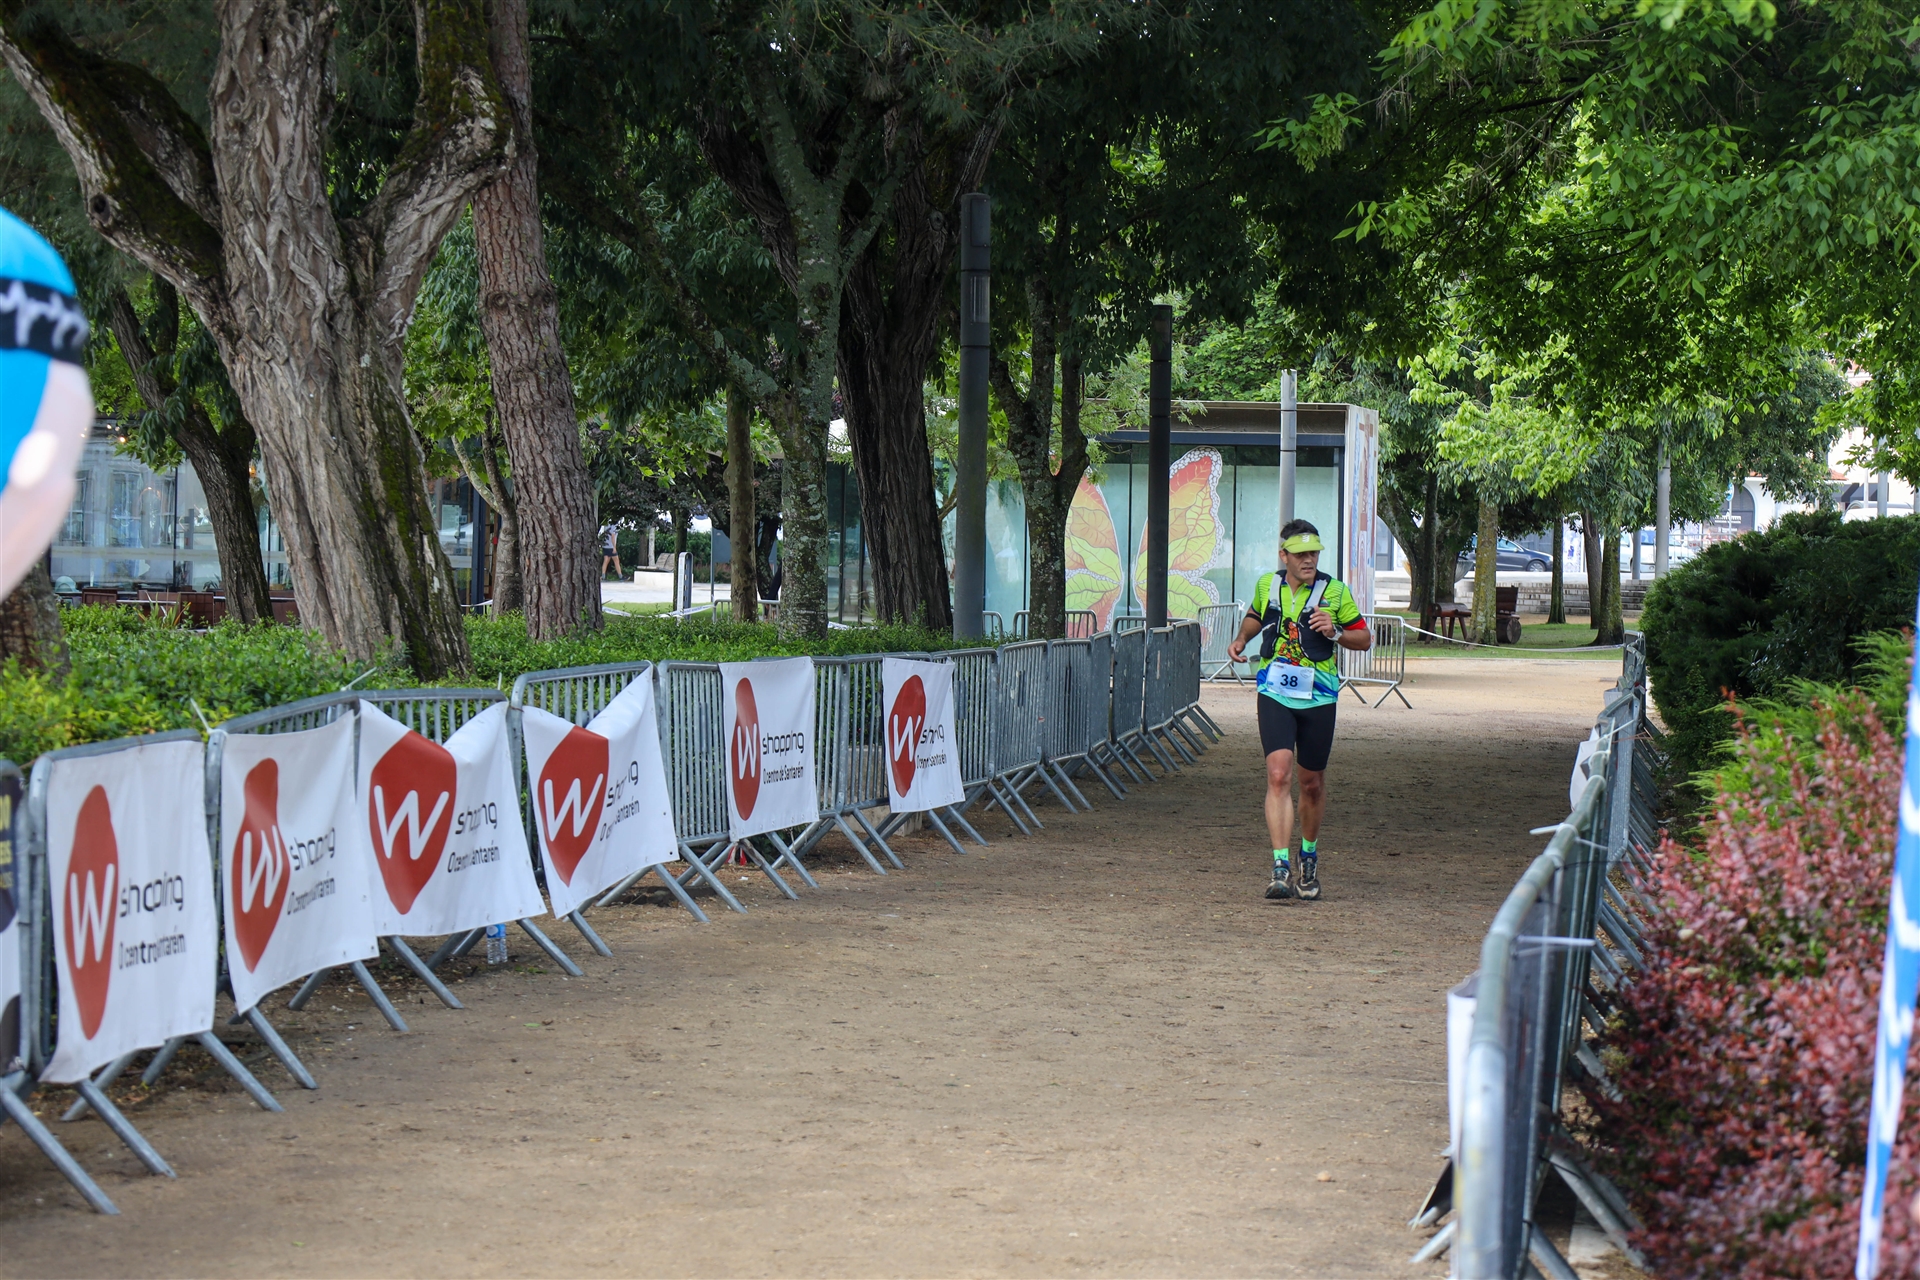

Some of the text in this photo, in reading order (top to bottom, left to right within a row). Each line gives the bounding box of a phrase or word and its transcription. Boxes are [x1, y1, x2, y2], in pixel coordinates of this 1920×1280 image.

[1280, 674, 1298, 687] 38
[737, 723, 757, 780] W
[762, 730, 805, 757] shopping
[893, 714, 921, 762] W
[374, 784, 449, 860] W
[544, 773, 603, 842] W
[241, 824, 282, 914] W
[70, 863, 115, 969] W
